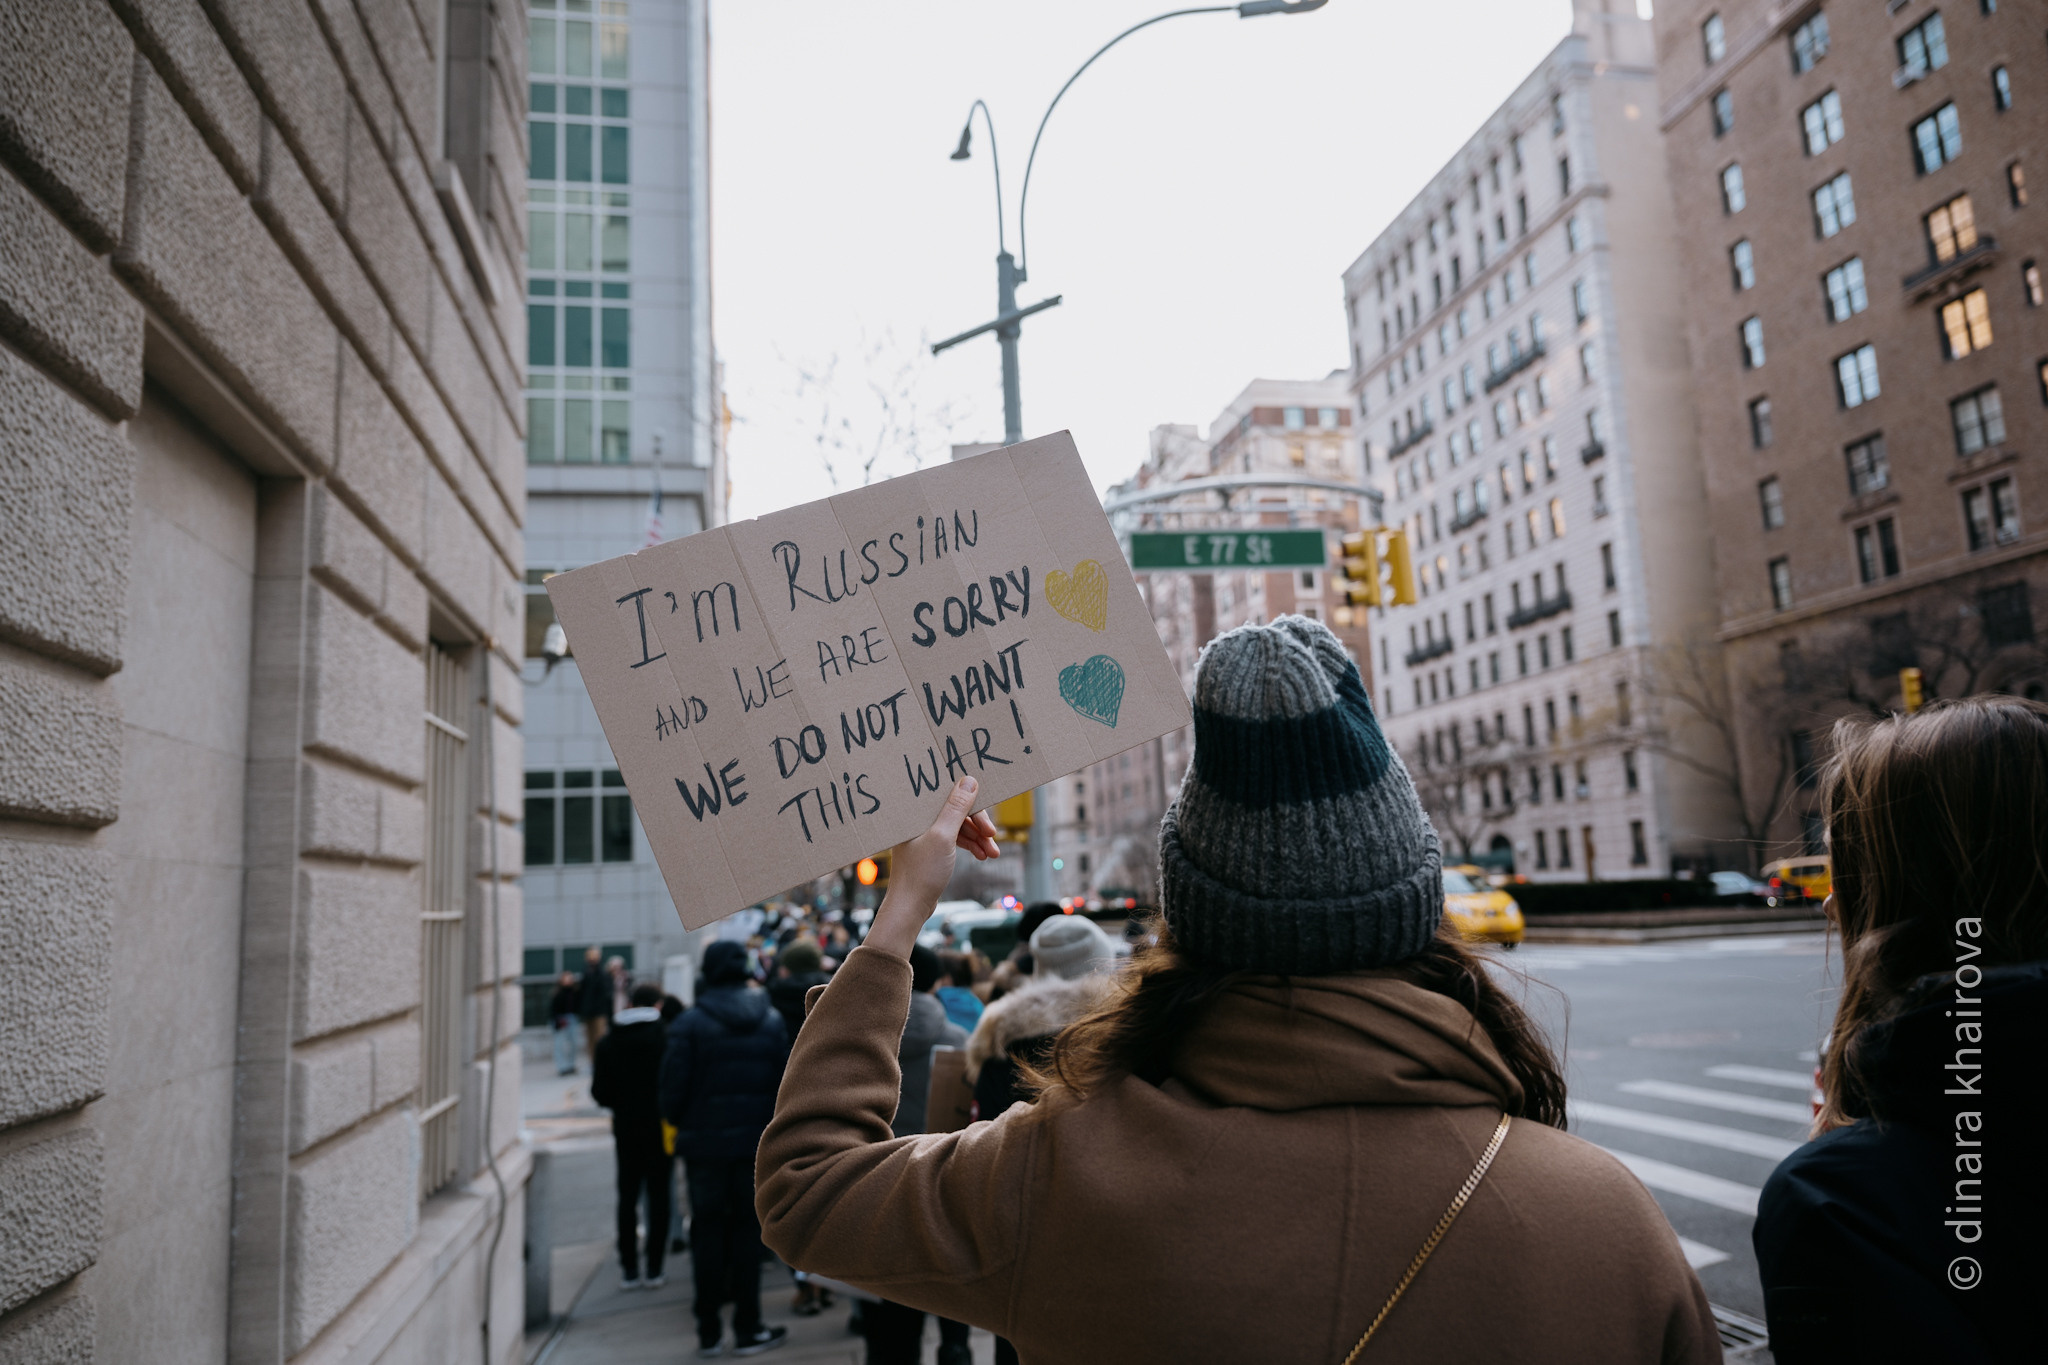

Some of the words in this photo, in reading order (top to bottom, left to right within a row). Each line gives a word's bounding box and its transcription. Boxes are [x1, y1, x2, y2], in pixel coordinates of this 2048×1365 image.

[1183, 537, 1202, 563] E
[1208, 536, 1238, 563] 77
[1245, 537, 1273, 563] St
[655, 694, 709, 741] AND
[733, 658, 794, 713] WE
[817, 627, 889, 683] ARE
[912, 565, 1030, 647] SORRY
[675, 757, 748, 822] WE
[769, 724, 827, 779] DO
[841, 688, 907, 754] NOT
[923, 639, 1028, 727] WANT
